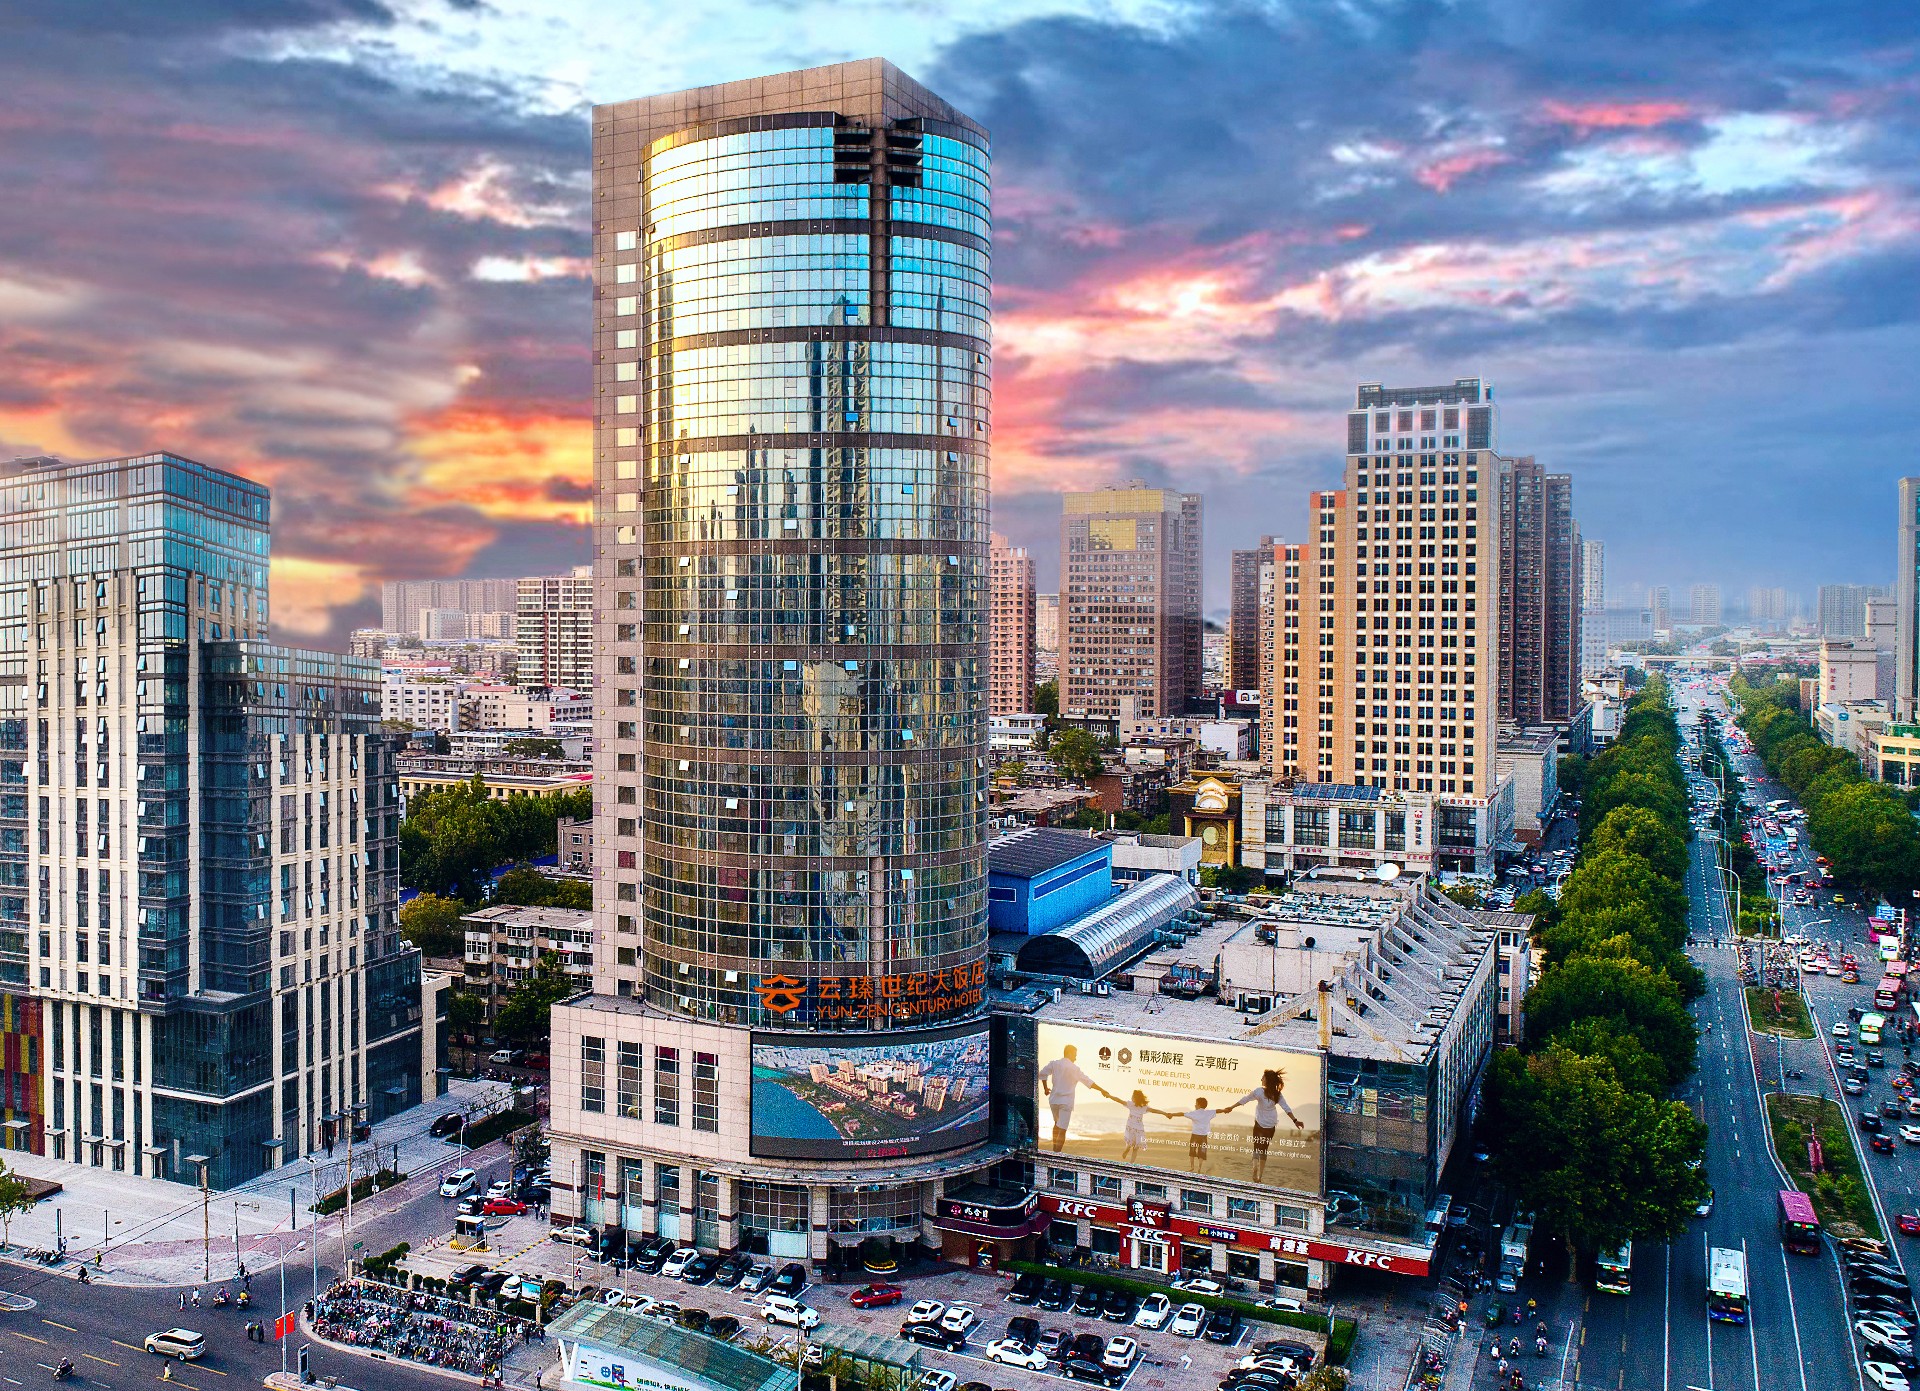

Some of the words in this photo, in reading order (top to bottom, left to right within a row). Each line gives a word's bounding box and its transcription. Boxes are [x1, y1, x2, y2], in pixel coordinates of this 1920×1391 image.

[817, 1005, 853, 1019] YUN
[857, 1004, 888, 1018] ZEN
[890, 997, 953, 1017] CENTURY
[954, 988, 984, 1008] HOTEL
[1139, 1049, 1184, 1066] 精彩旅程
[1194, 1055, 1239, 1071] 云享随行
[1169, 1070, 1191, 1080] ELITES
[1137, 1078, 1152, 1086] WILL
[1161, 1080, 1178, 1088] WITH
[1178, 1082, 1196, 1090] YOUR
[1196, 1083, 1225, 1092] JOURNEY
[1057, 1200, 1098, 1218] KFC
[1145, 1209, 1165, 1218] KFC
[1131, 1226, 1164, 1241] KFC
[1269, 1237, 1309, 1255] 肯德基
[1344, 1249, 1392, 1270] KFC
